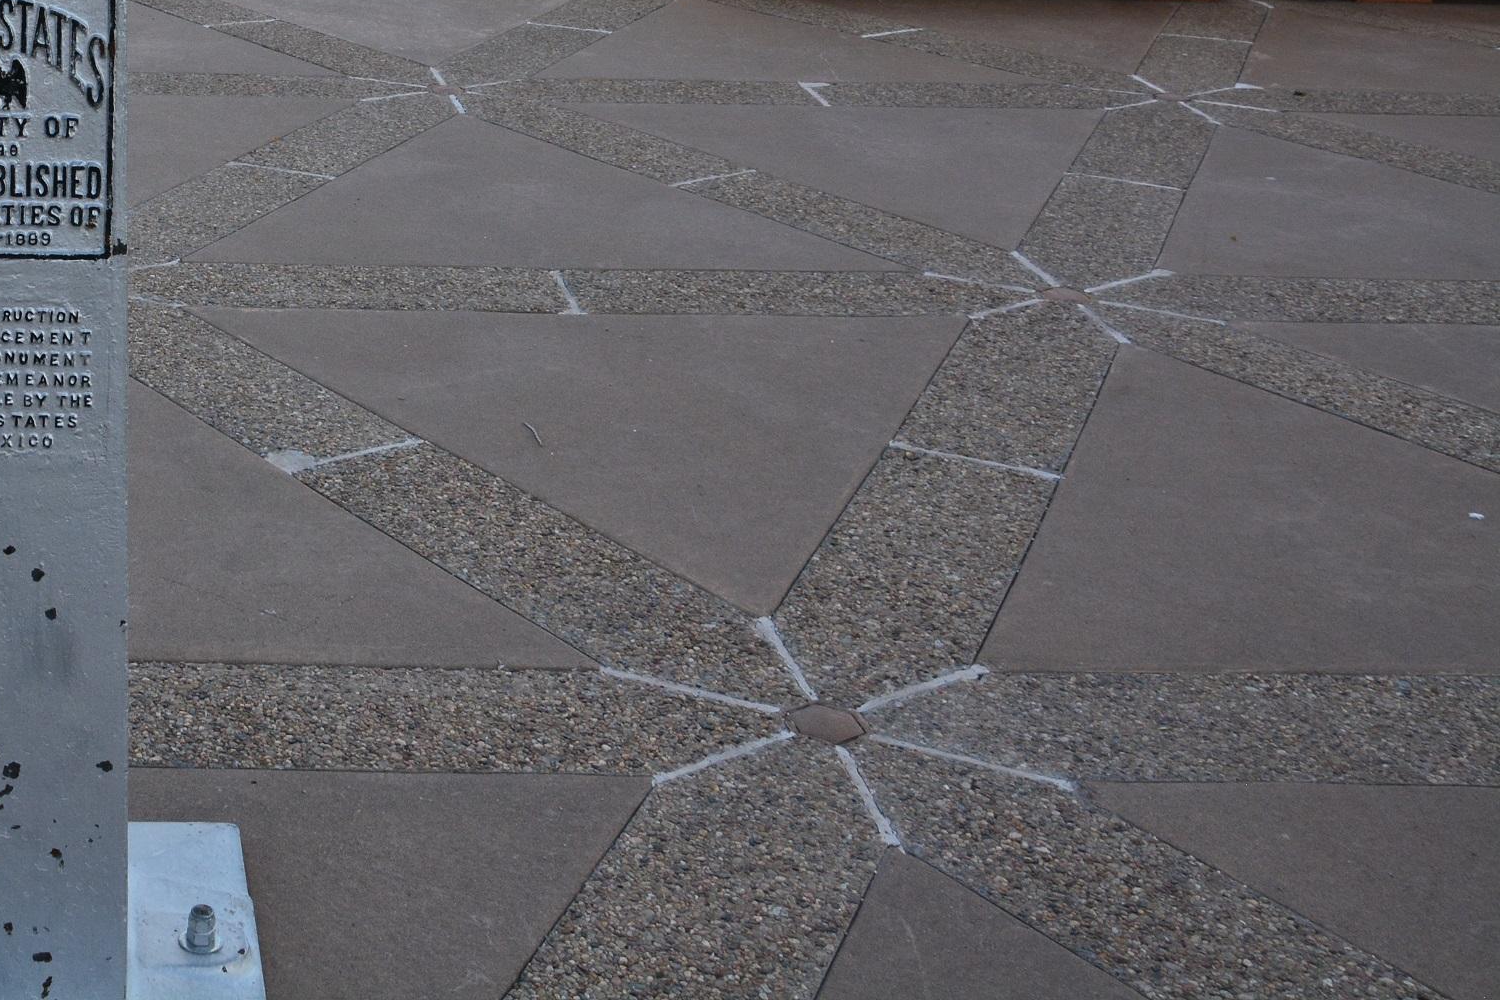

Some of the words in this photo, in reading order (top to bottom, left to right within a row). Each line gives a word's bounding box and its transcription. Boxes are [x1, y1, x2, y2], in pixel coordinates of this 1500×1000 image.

[44, 115, 80, 139] OF
[69, 206, 101, 228] OF
[23, 393, 48, 407] BY
[57, 394, 93, 408] THE
